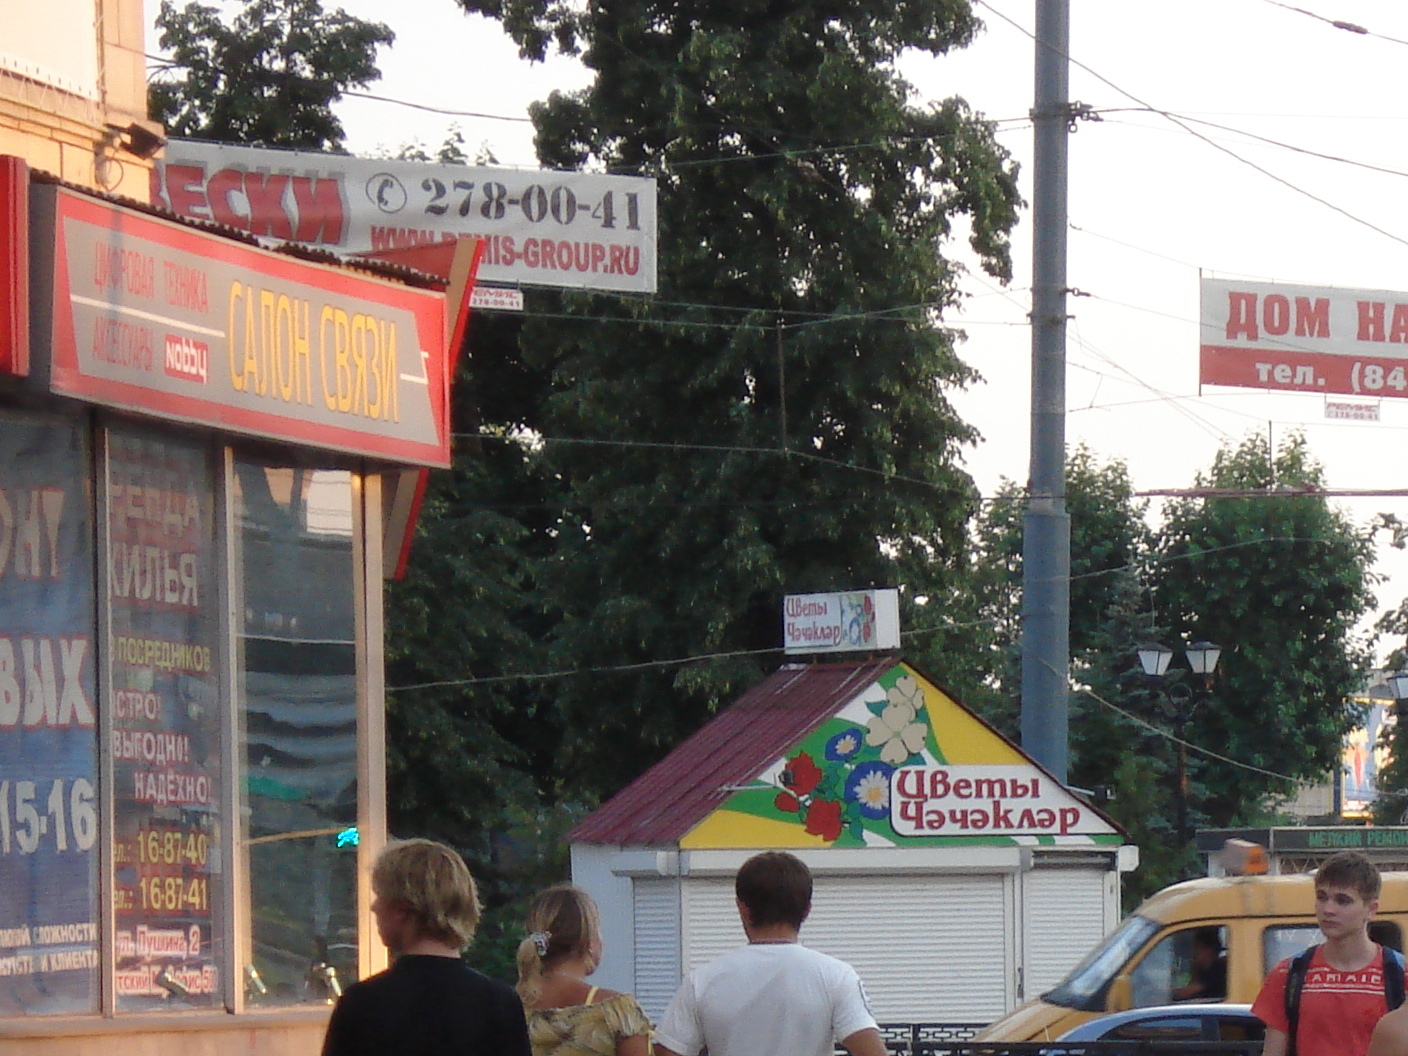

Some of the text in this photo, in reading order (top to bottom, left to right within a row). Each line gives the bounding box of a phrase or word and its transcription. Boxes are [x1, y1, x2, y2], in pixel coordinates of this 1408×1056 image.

[421, 177, 641, 231] 278-00-41
[1226, 292, 1331, 342] ДОМ
[229, 280, 400, 424] САЛОН СВЯЗИ
[1256, 362, 1326, 386] тел.
[786, 597, 828, 618] Цветы
[118, 635, 211, 672] ПОСРЕДНИКОВ
[897, 770, 1041, 802] Цветы
[900, 800, 1081, 835] Чәчәкләр
[138, 831, 207, 865] 16-87-40
[140, 877, 207, 910] 16-87-41
[191, 930, 199, 953] 2
